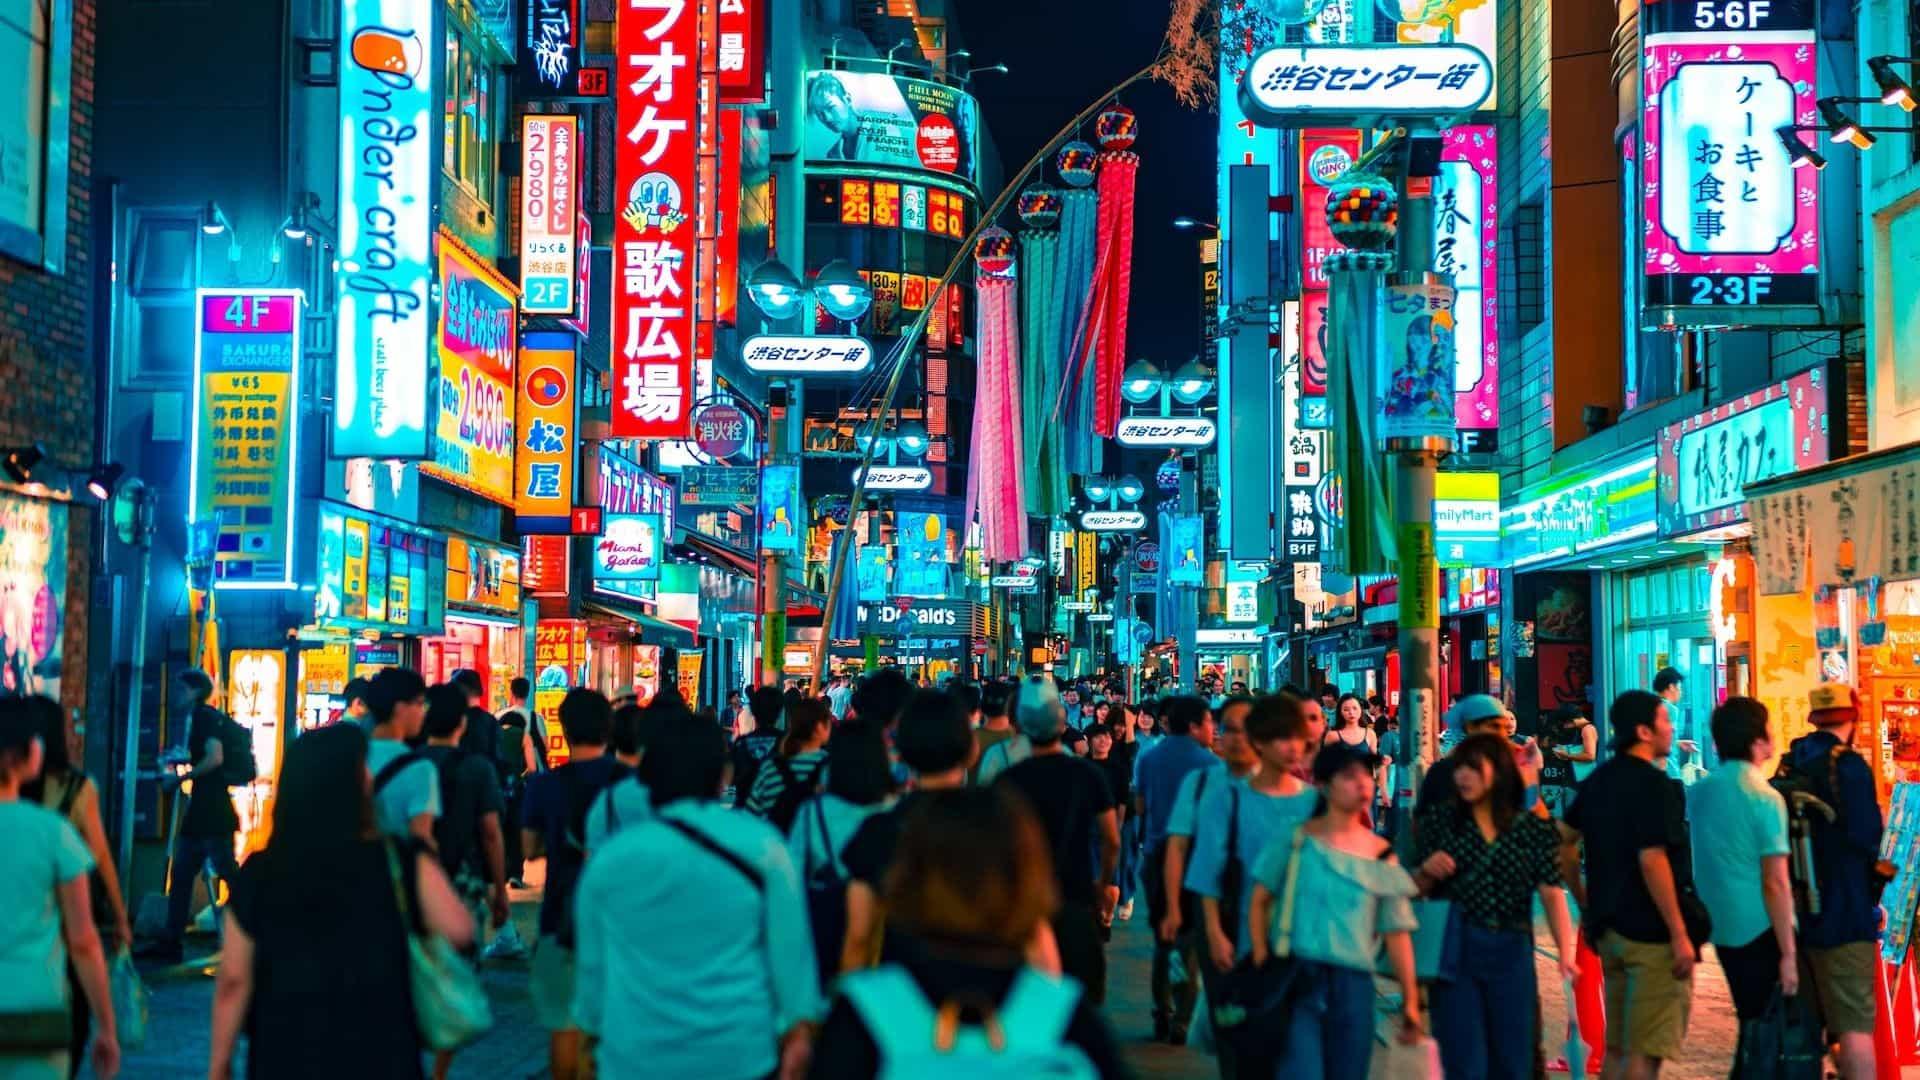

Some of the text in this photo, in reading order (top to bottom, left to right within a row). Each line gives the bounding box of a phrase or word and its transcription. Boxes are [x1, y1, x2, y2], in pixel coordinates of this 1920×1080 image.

[584, 73, 604, 91] 3F
[1261, 64, 1480, 91] 渋谷センター街
[1735, 76, 1763, 203] ケーキと
[1318, 162, 1346, 177] KING
[1694, 140, 1726, 241] お食事
[346, 206, 420, 323] craft
[528, 261, 567, 273] 渋谷店
[532, 283, 563, 303] 2F
[224, 296, 270, 328] 4F
[623, 241, 684, 422] 歌広場
[223, 343, 292, 356] SAKURA
[751, 347, 865, 362] 渋谷センター街
[700, 420, 743, 441] 消火栓
[1122, 425, 1211, 437] 渋谷センター街
[526, 418, 567, 498] 松屋
[857, 471, 928, 484] 谷センター街
[1436, 508, 1493, 522] milyMart
[597, 540, 642, 553] Miami
[1289, 544, 1316, 556] B1F
[604, 555, 655, 571] Garden
[857, 606, 956, 625] MDald's
[537, 627, 570, 642] ラオケ
[537, 643, 569, 659] 広場
